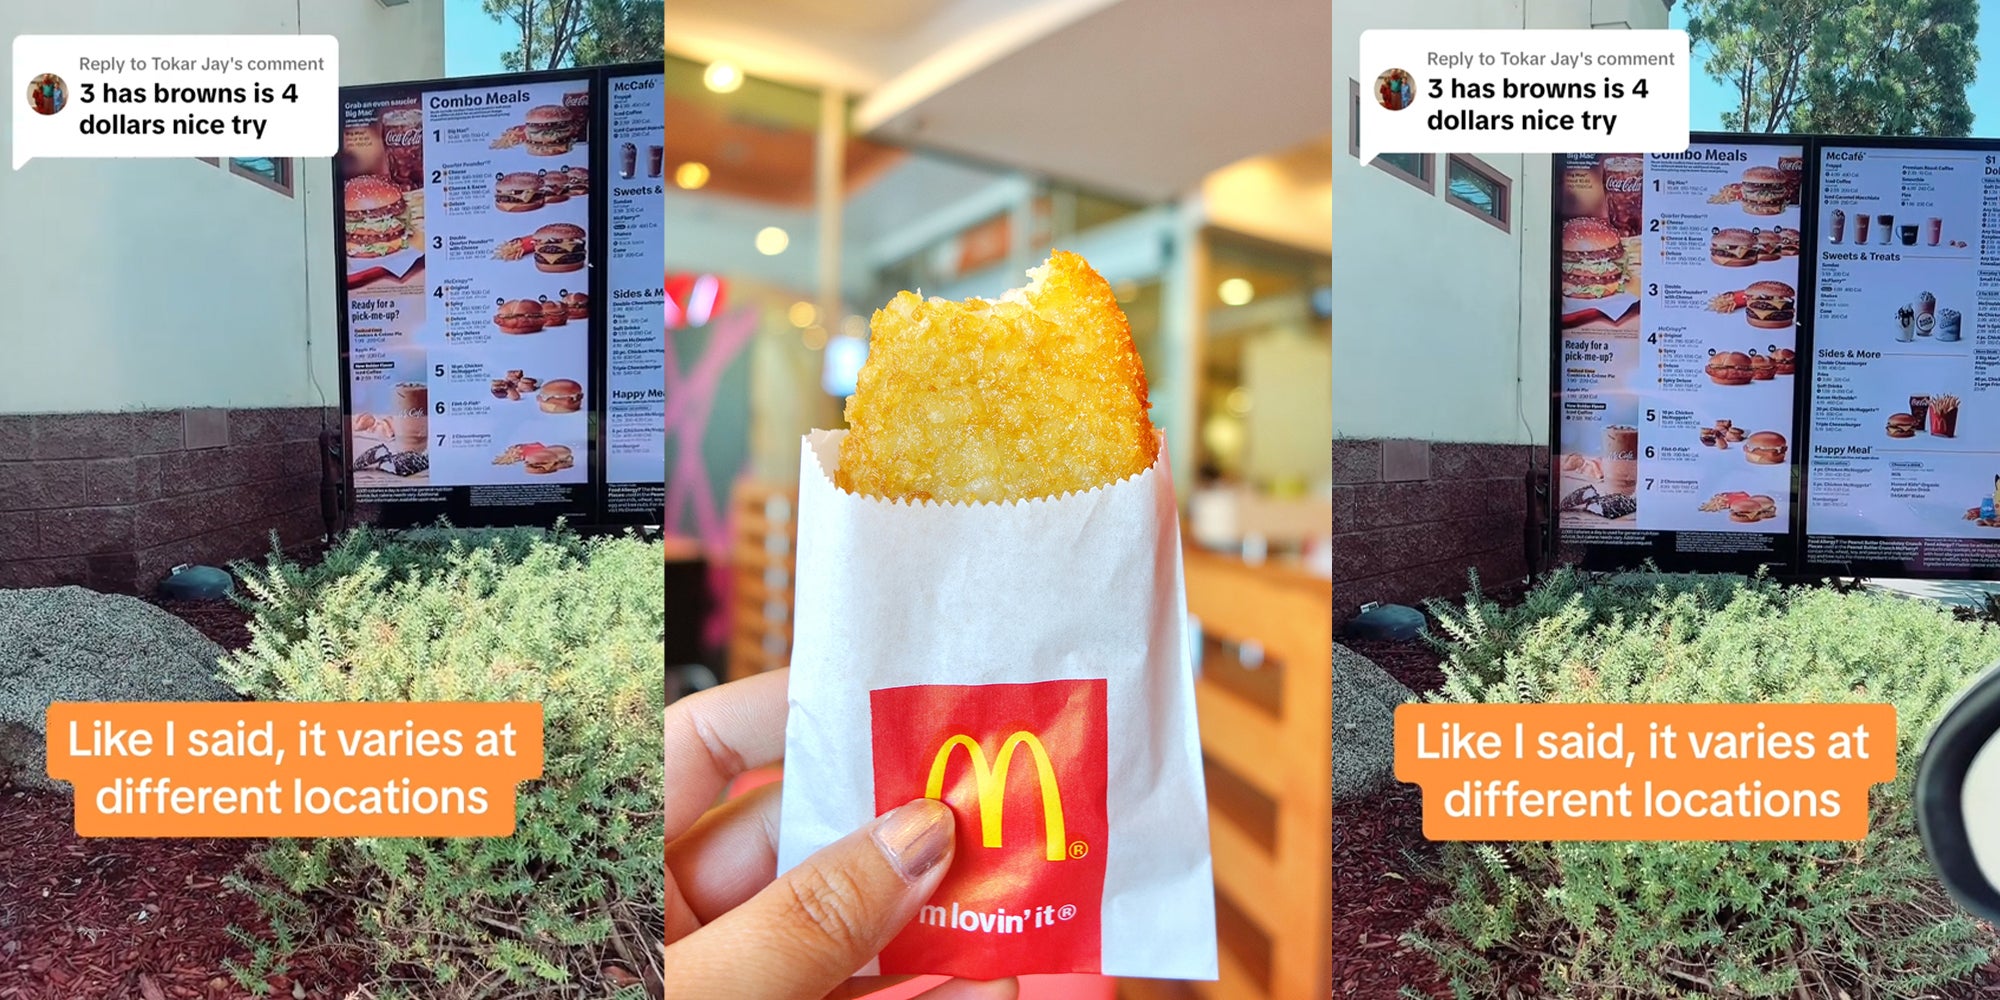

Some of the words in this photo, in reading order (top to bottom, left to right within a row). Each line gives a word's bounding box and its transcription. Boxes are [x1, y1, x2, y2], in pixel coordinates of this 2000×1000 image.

[430, 94, 482, 109] Combo
[486, 90, 530, 105] Meals
[346, 110, 356, 118] Big
[433, 129, 440, 142] 1
[1705, 149, 1747, 161] Meals
[1985, 155, 1996, 164] $1
[432, 170, 441, 184] 2
[1985, 167, 2000, 175] Dol
[614, 186, 652, 196] Sweets
[655, 185, 662, 194] &
[1653, 179, 1659, 192] 1
[1650, 219, 1659, 232] 2
[433, 236, 442, 249] 3
[1823, 251, 1858, 260] Sweets
[1860, 252, 1867, 260] &
[1870, 252, 1900, 261] Treats
[433, 286, 443, 298] 4
[613, 289, 642, 299] Sides
[644, 289, 651, 297] &
[655, 288, 664, 297] M
[1649, 283, 1658, 296] 3
[352, 300, 375, 311] Ready
[377, 299, 388, 308] for
[352, 310, 400, 323] pick-me-up?
[1647, 332, 1657, 344] 4
[1565, 340, 1589, 352] Ready
[1591, 340, 1602, 350] for
[1565, 351, 1613, 363] pick-me-up?
[1818, 349, 1845, 358] Sides
[1847, 350, 1854, 358] &
[1856, 350, 1881, 359] More
[435, 364, 444, 377] 5
[612, 390, 645, 400] Happy
[648, 389, 665, 398] Mea
[436, 401, 445, 414] 6
[1646, 409, 1655, 421] 5
[436, 434, 446, 446] 7
[1645, 446, 1655, 458] 6
[1815, 445, 1845, 455] Happy
[1645, 478, 1654, 490] 7
[952, 902, 1031, 934] lovin'
